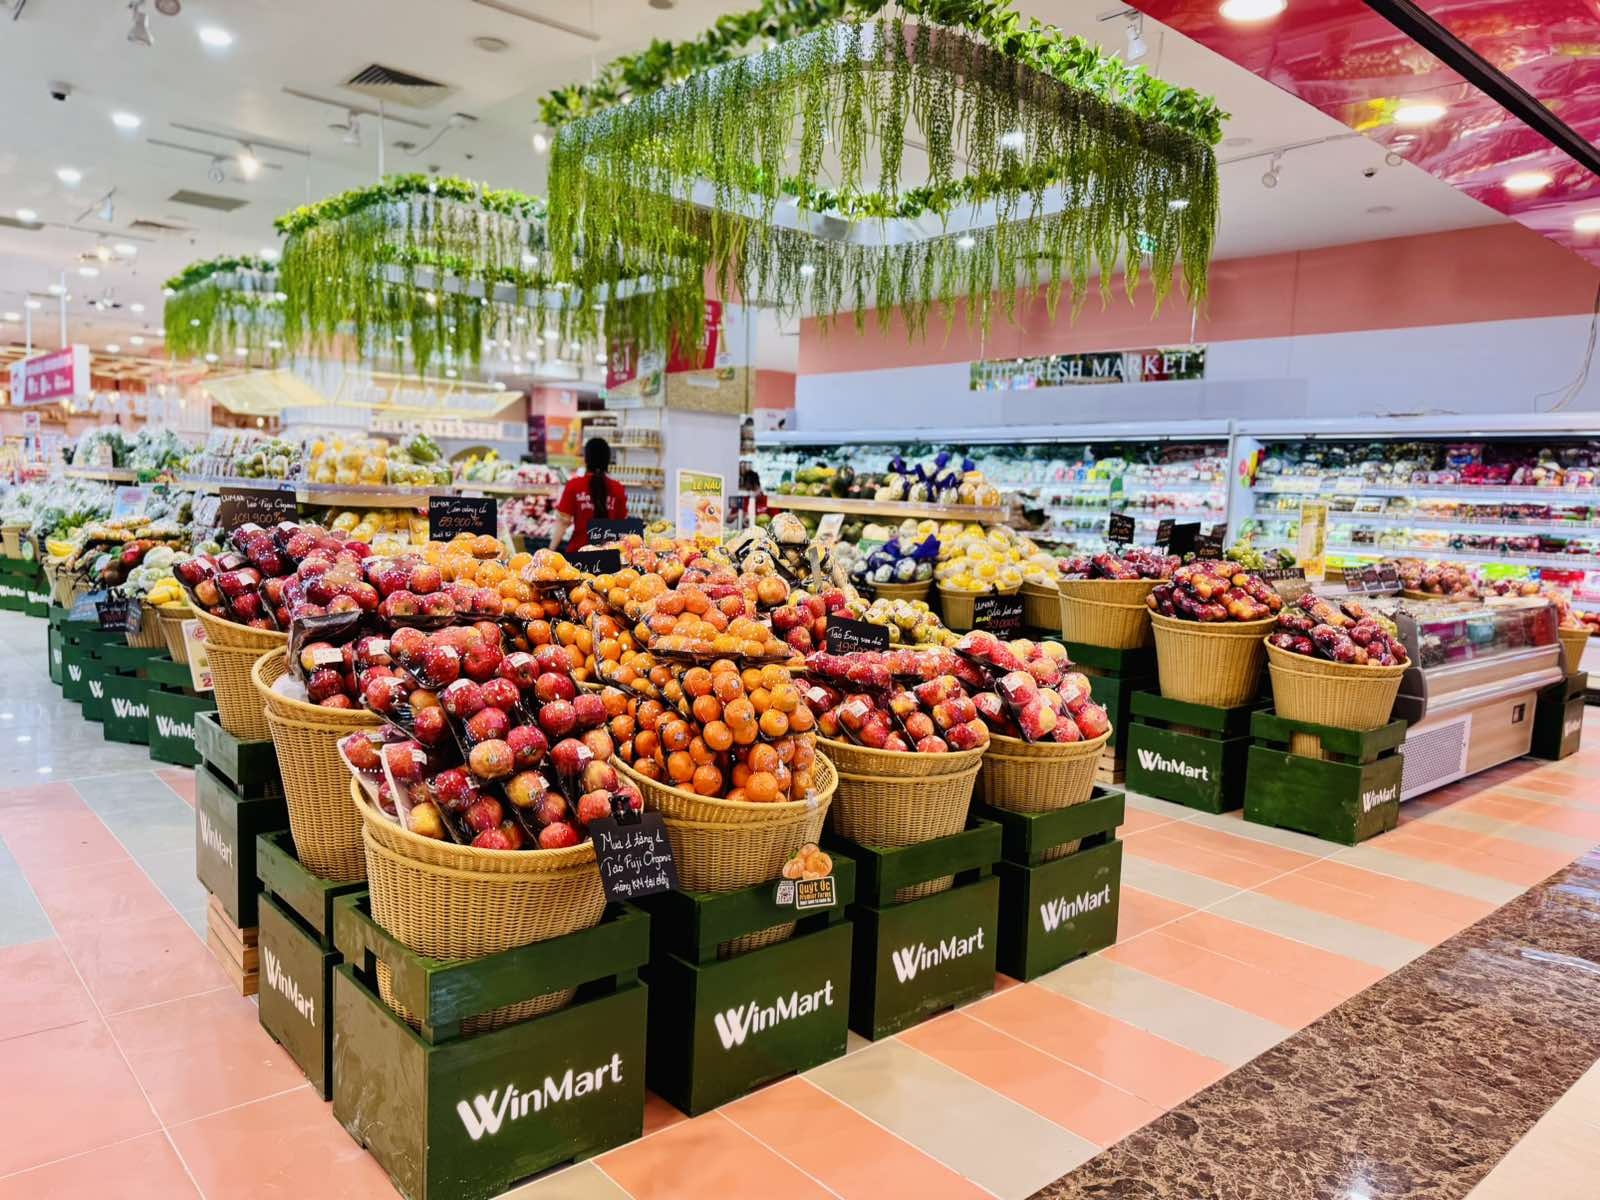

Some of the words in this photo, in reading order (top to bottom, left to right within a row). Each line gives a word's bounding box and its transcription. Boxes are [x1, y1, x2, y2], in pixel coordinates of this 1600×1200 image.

[980, 362, 1015, 382] THE
[1023, 359, 1083, 381] FRESH
[1092, 352, 1191, 378] MARKET
[1136, 748, 1209, 782] WinMart
[1362, 784, 1397, 814] WinMart
[200, 808, 233, 868] WinMart
[600, 831, 623, 851] Mua
[1040, 884, 1111, 933] WinMart
[891, 927, 985, 984] WinMart
[264, 946, 316, 1027] WinMart
[714, 979, 834, 1050] WinMart
[456, 1053, 623, 1140] WinMart
